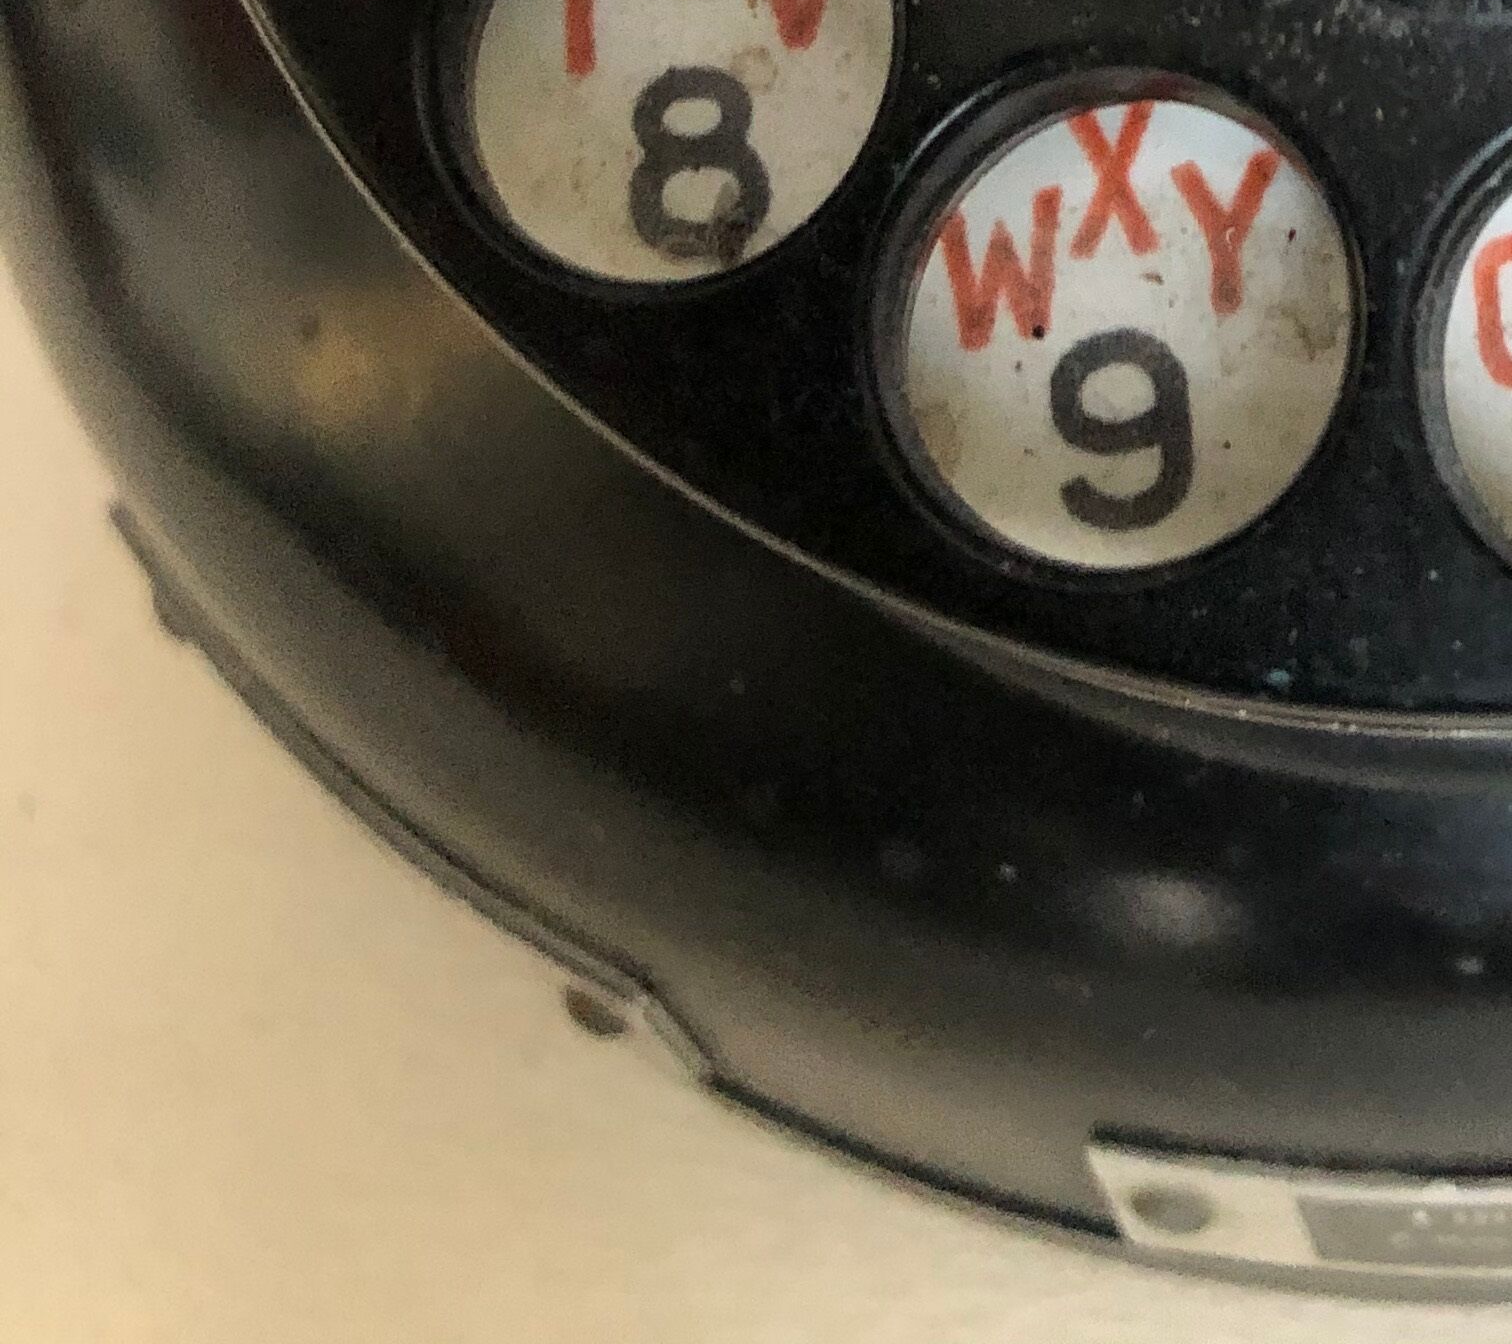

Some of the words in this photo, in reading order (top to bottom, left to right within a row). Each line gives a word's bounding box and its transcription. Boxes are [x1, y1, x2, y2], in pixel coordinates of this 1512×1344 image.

[628, 65, 772, 262] 8
[940, 99, 1280, 352] WXY
[1048, 326, 1195, 532] 9
